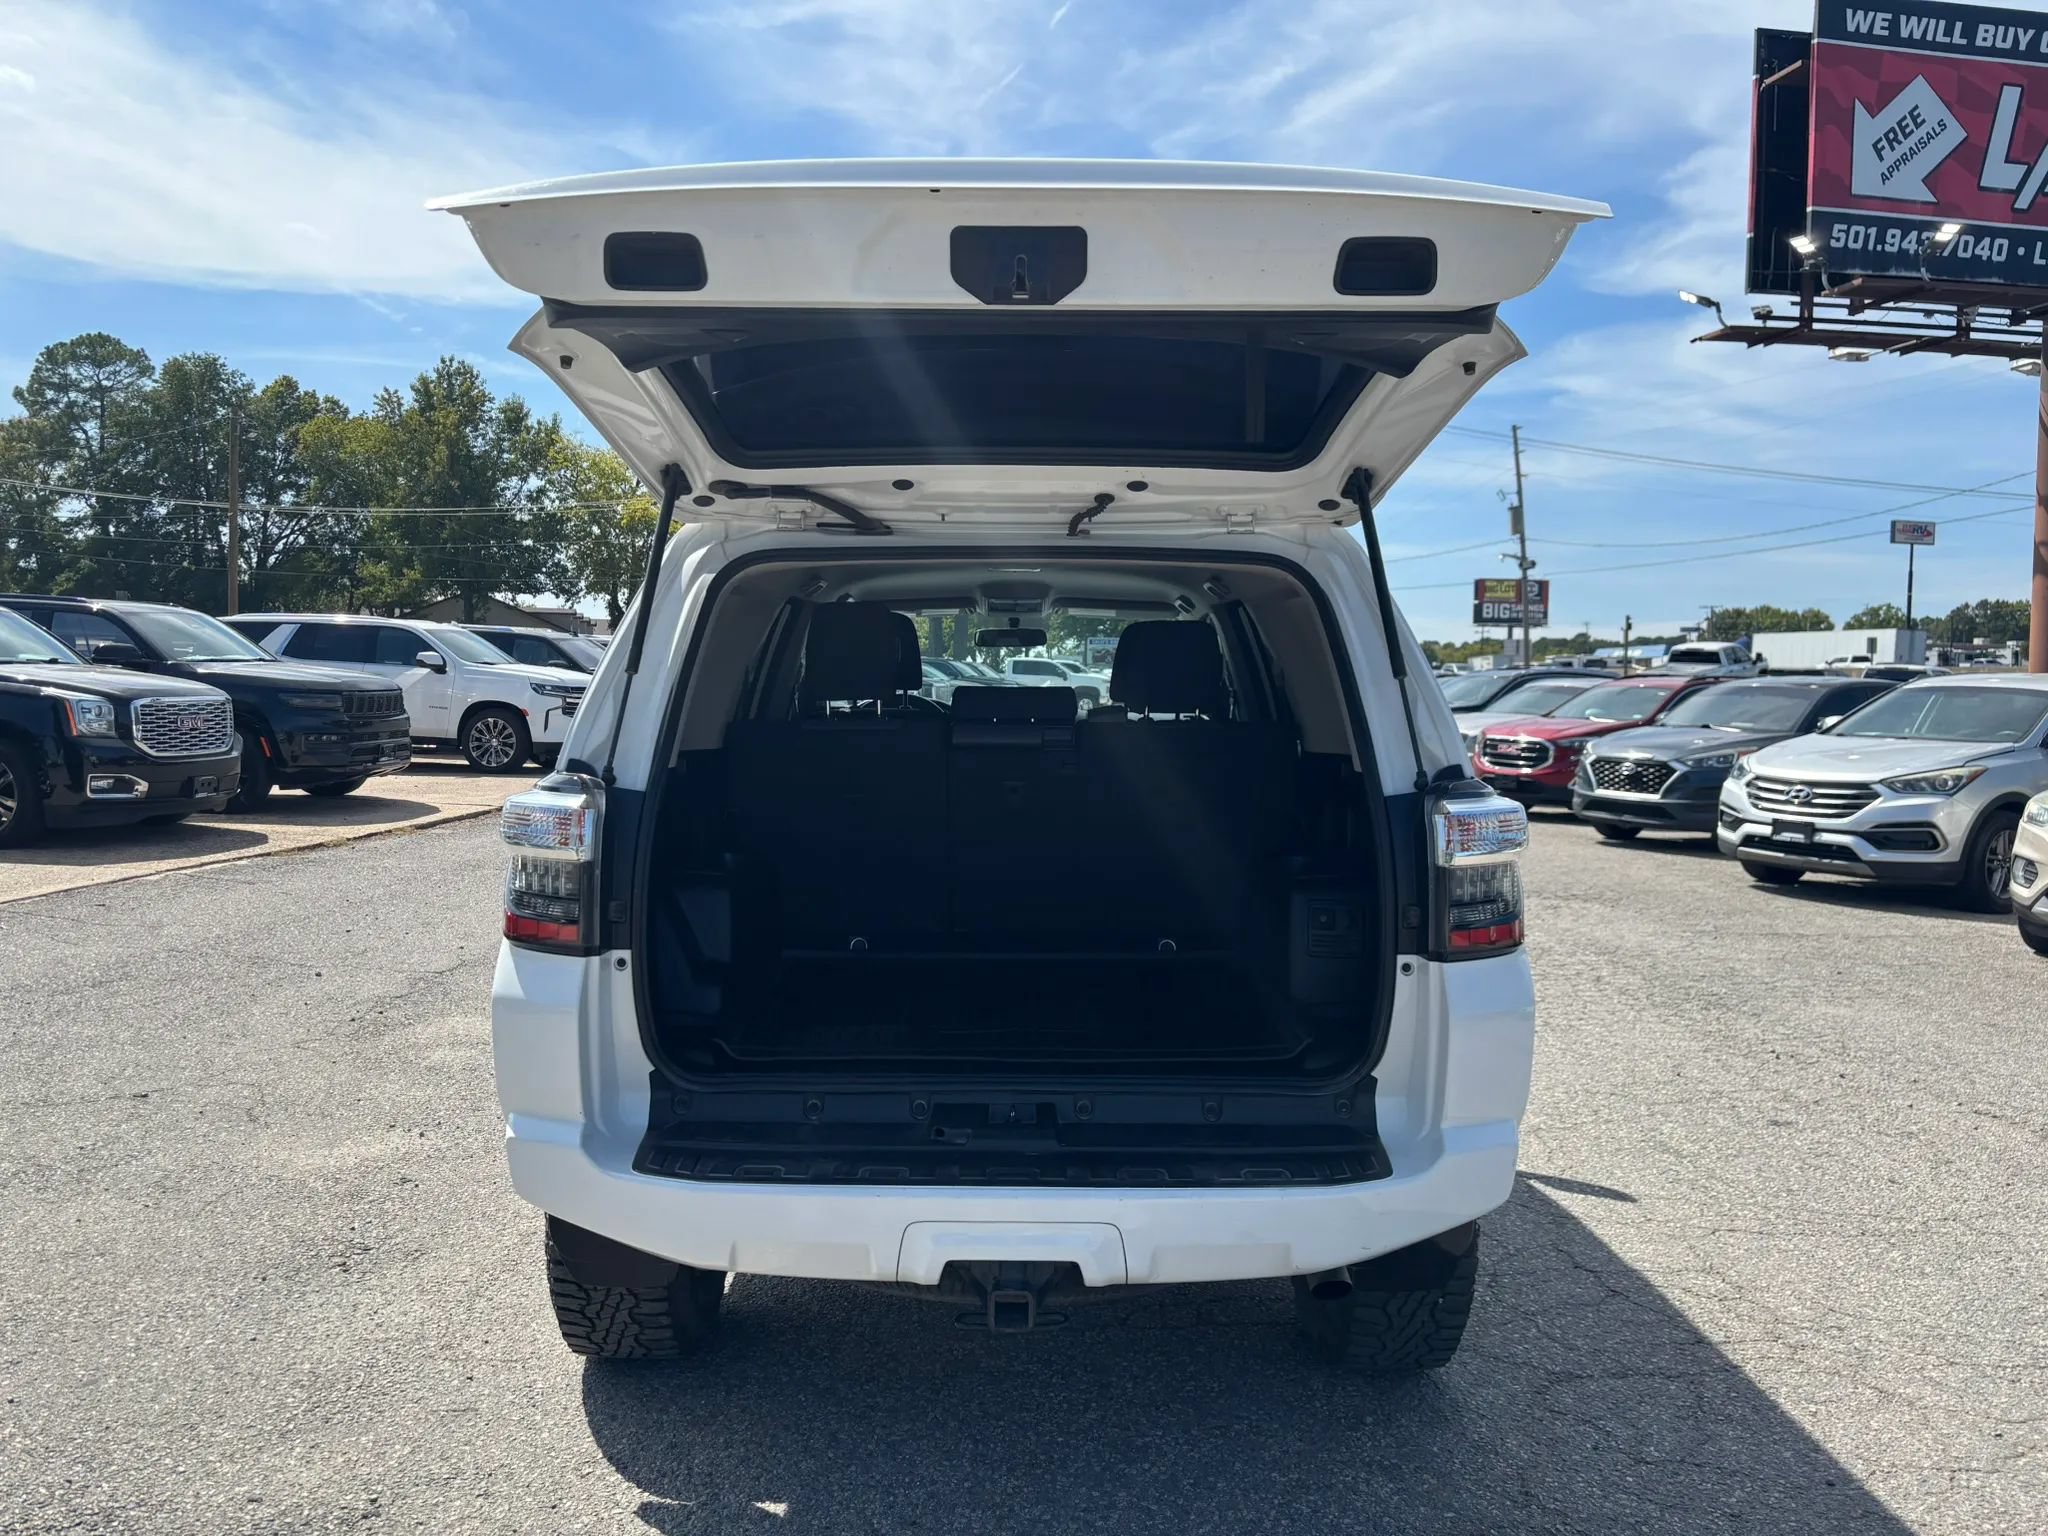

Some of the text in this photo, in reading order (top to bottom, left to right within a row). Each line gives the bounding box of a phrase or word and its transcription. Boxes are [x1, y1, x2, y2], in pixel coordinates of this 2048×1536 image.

[1845, 8, 1893, 36] WE
[1899, 14, 1968, 45] WILL
[1975, 23, 2036, 51] BUY
[1871, 103, 1927, 163] FREE
[1880, 118, 1948, 186] APPRAISALS
[1482, 603, 1510, 619] BIG
[177, 715, 210, 729] GMC
